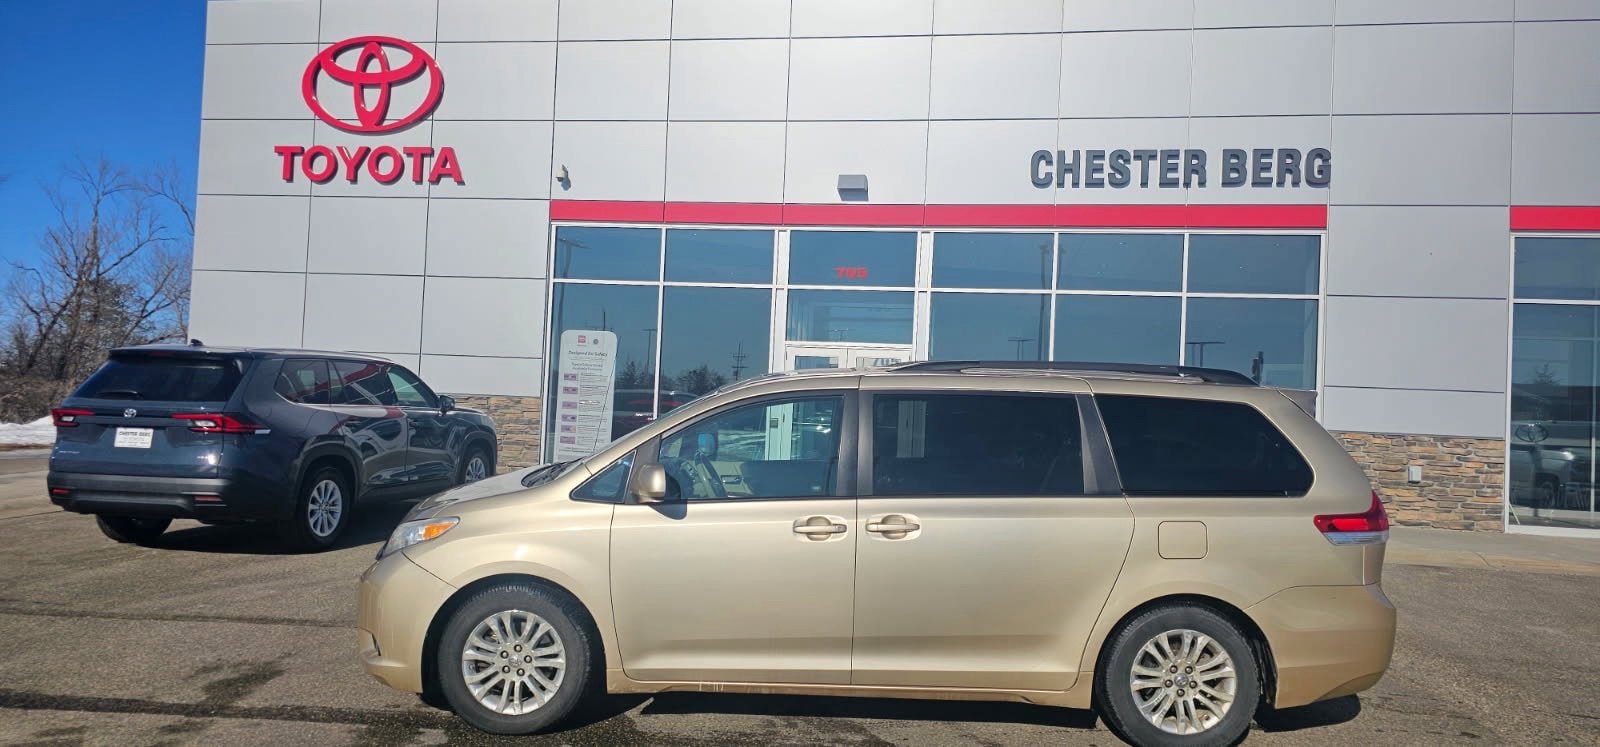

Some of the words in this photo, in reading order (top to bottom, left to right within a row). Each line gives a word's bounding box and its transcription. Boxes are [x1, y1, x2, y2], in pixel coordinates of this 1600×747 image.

[274, 145, 465, 185] TOYOTA
[1030, 149, 1207, 188] CHESTER
[1221, 148, 1332, 188] BERG
